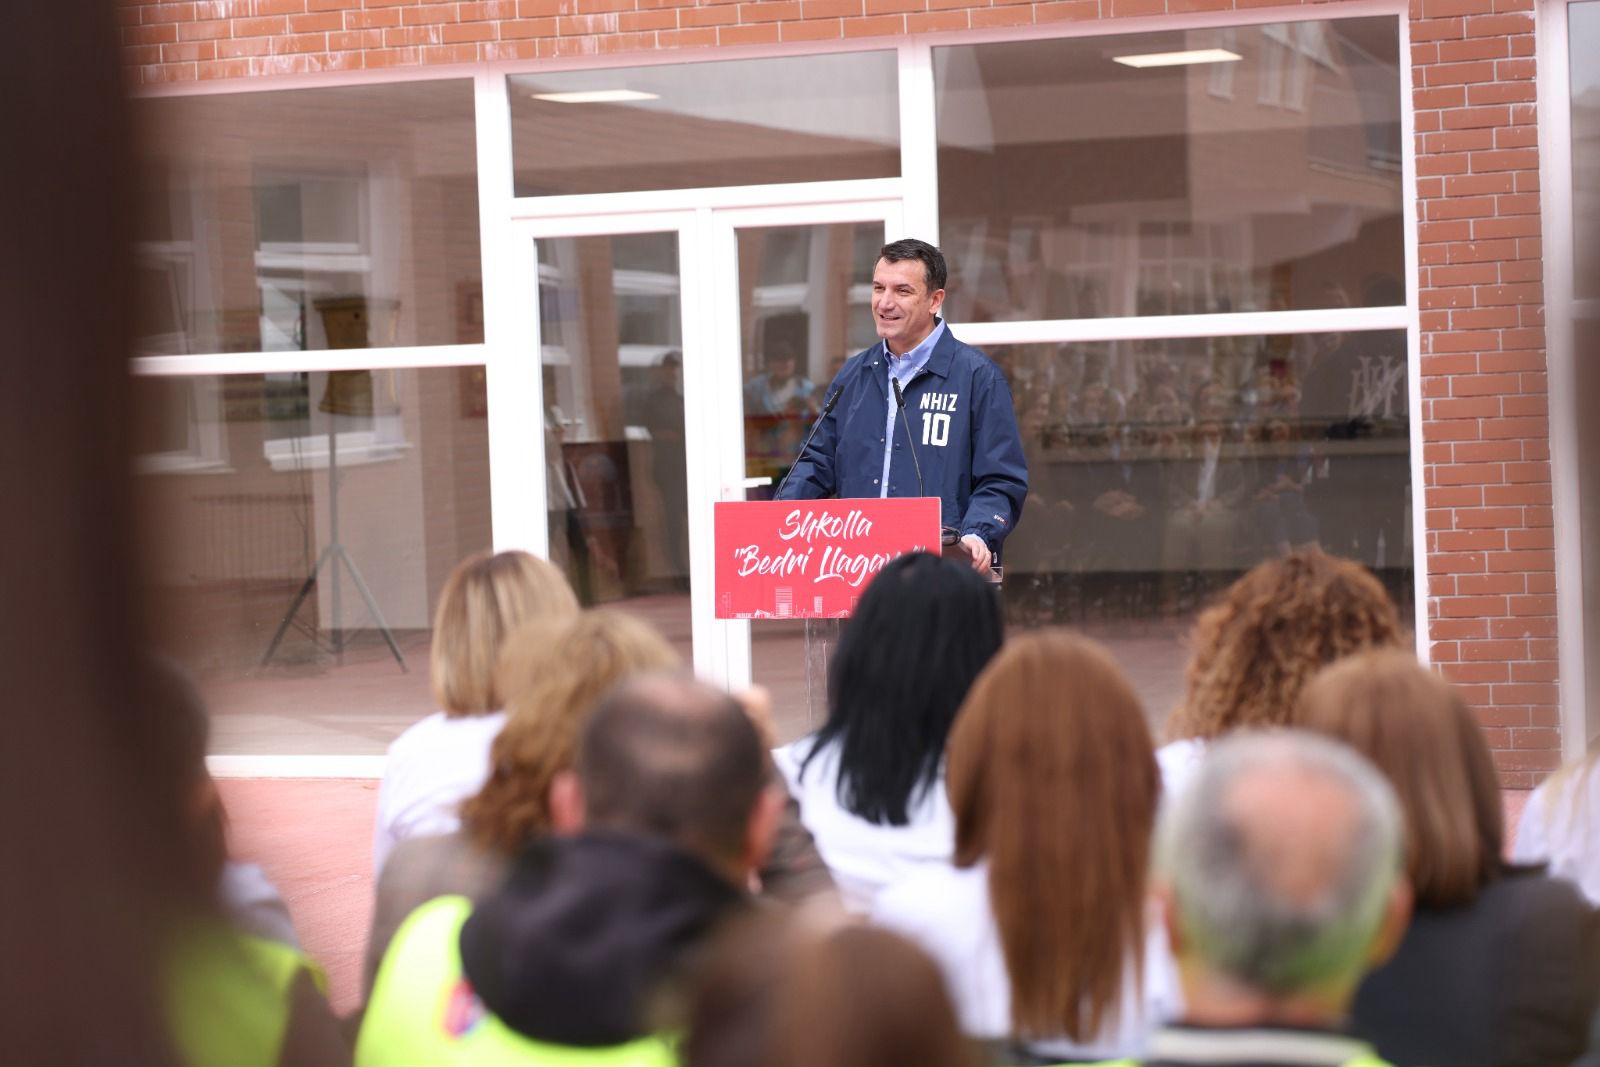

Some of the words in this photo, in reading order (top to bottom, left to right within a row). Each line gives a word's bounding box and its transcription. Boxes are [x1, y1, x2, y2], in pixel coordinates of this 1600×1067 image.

[919, 392, 958, 412] NHIZ
[922, 412, 951, 447] 10
[778, 509, 873, 543] Shkolla
[734, 544, 813, 578] "Bedri
